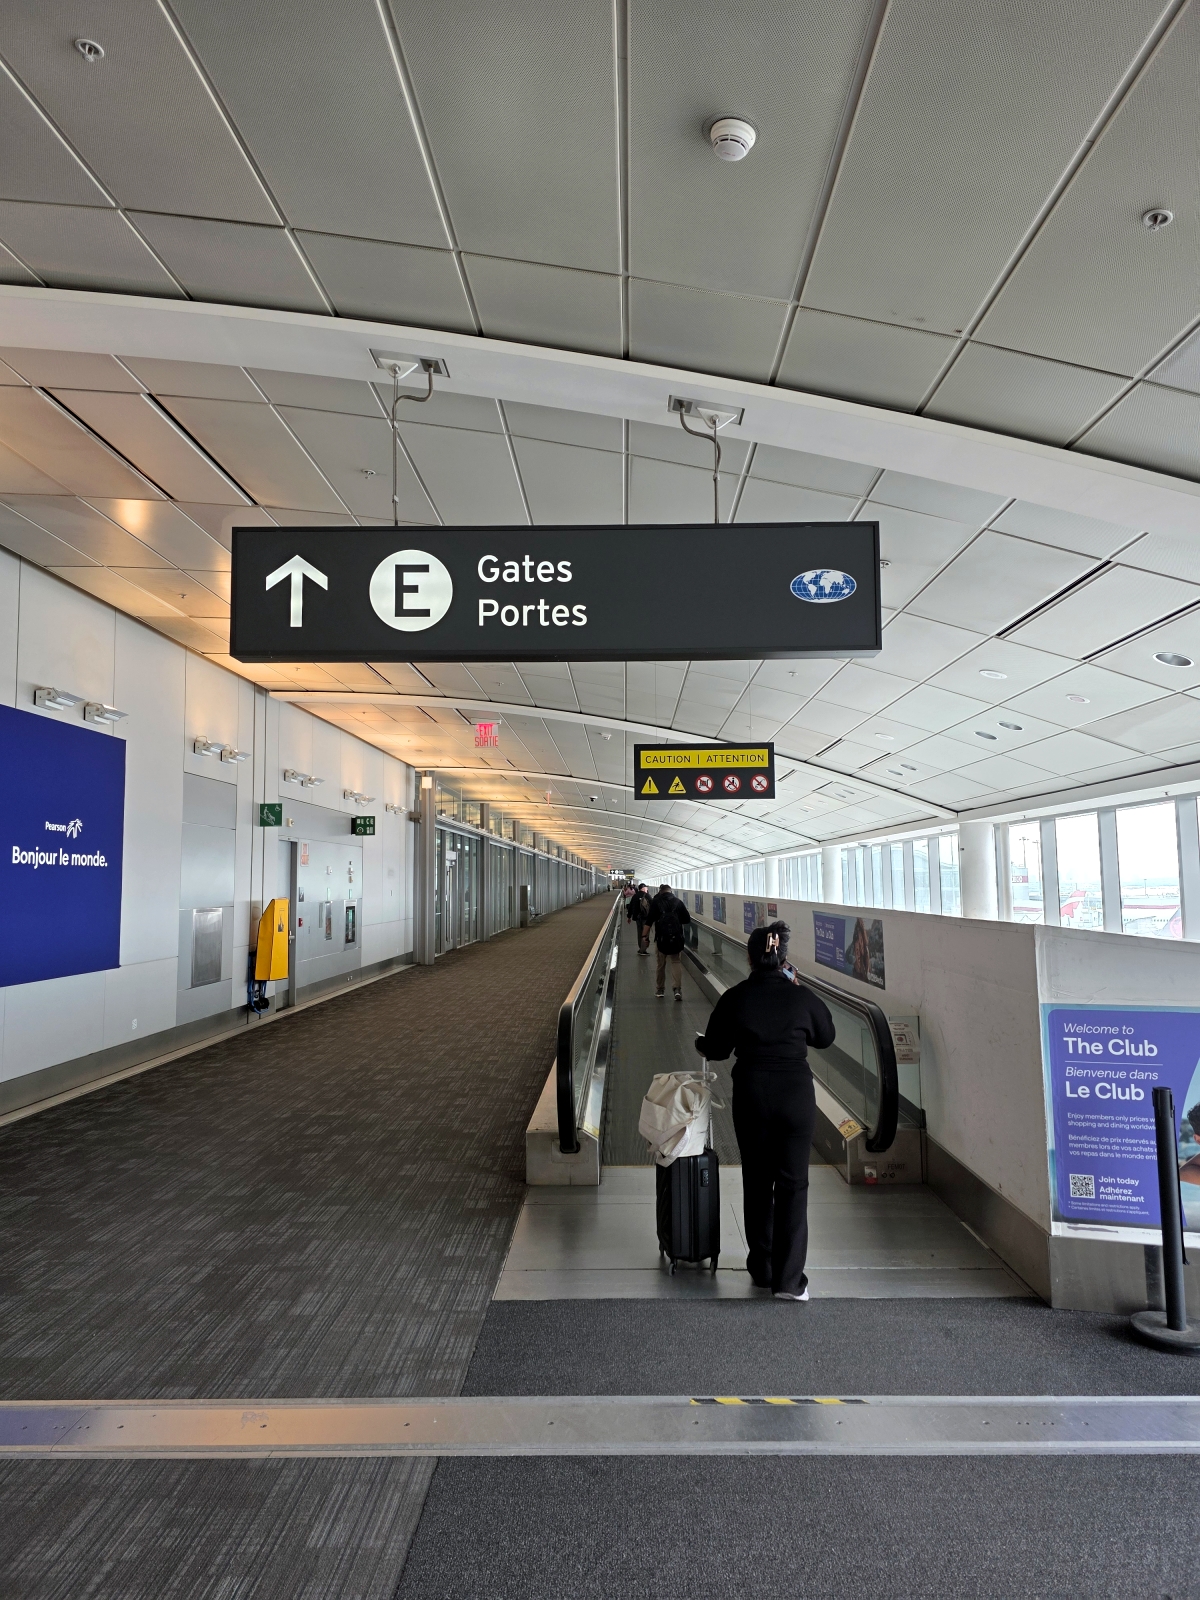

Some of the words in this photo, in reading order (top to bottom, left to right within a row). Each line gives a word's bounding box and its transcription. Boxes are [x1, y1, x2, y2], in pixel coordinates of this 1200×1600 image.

[477, 554, 573, 583] Gates
[395, 565, 430, 617] E
[478, 598, 588, 627] Portes
[478, 723, 493, 736] EXIT
[474, 735, 499, 747] SORTIE
[645, 755, 691, 764] CAUTION
[706, 754, 765, 763] ATTENTION
[45, 820, 67, 832] Pearson
[12, 845, 58, 870] Bonjour
[59, 847, 69, 866] le
[70, 849, 108, 868] monde.
[1063, 1023, 1119, 1035] Welcome
[1122, 1024, 1135, 1035] to
[1063, 1037, 1104, 1055] The
[1108, 1038, 1158, 1057] Club
[1065, 1067, 1126, 1080] Bienvenue
[1129, 1068, 1159, 1081] dans
[1065, 1081, 1090, 1099] Le
[1095, 1082, 1145, 1101] Club
[1067, 1112, 1085, 1120] Enjoy
[1129, 1115, 1149, 1123] prices
[1067, 1120, 1096, 1128] shopping
[1110, 1122, 1129, 1130] dining
[1098, 1176, 1116, 1184] Join
[1117, 1177, 1140, 1186] today
[1099, 1186, 1133, 1195] Adhérez
[1099, 1193, 1145, 1203] maintenant
